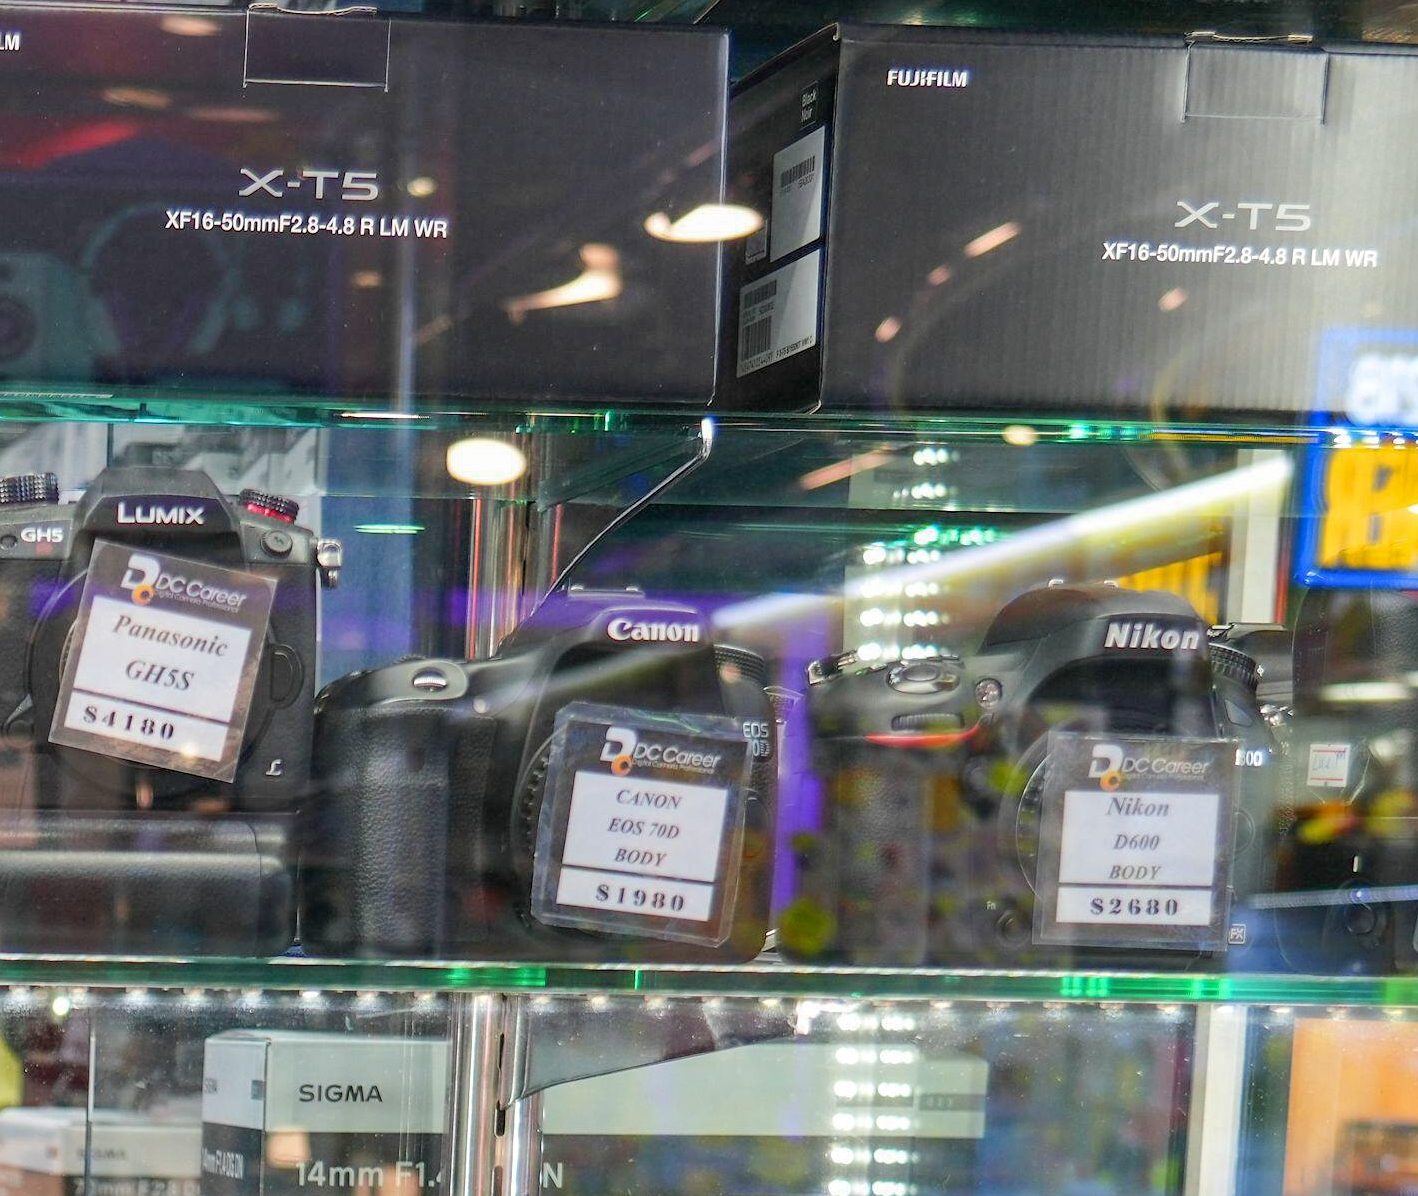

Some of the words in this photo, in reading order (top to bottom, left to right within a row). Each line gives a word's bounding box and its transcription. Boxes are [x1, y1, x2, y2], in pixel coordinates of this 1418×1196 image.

[886, 68, 967, 88] FUJIFILM
[239, 168, 380, 200] X-T5
[165, 210, 355, 237] XF16-50mmF2.8-4.8
[379, 217, 408, 237] LM
[414, 218, 448, 239] WR
[1173, 201, 1312, 231] X-T5
[1101, 241, 1288, 266] XF16-50mmF2.8-4.8
[1311, 249, 1340, 267] LM
[1345, 250, 1378, 268] WR
[117, 502, 207, 527] LUMIX
[20, 526, 64, 544] GH5
[111, 613, 230, 659] Panasonic
[607, 616, 701, 643] Canon
[1103, 621, 1201, 652] Nikon
[124, 660, 196, 692] GH5S
[742, 721, 769, 739] EOS
[1151, 758, 1211, 776] Career
[616, 788, 684, 812] CANON
[1106, 797, 1171, 818] Nikon
[607, 818, 645, 837] EOS
[647, 821, 680, 841] 70D
[1113, 833, 1160, 852] D600
[613, 847, 669, 868] BODY
[1108, 863, 1163, 882] BODY
[297, 1083, 384, 1104] SIGMA
[295, 1160, 386, 1188] 14mm
